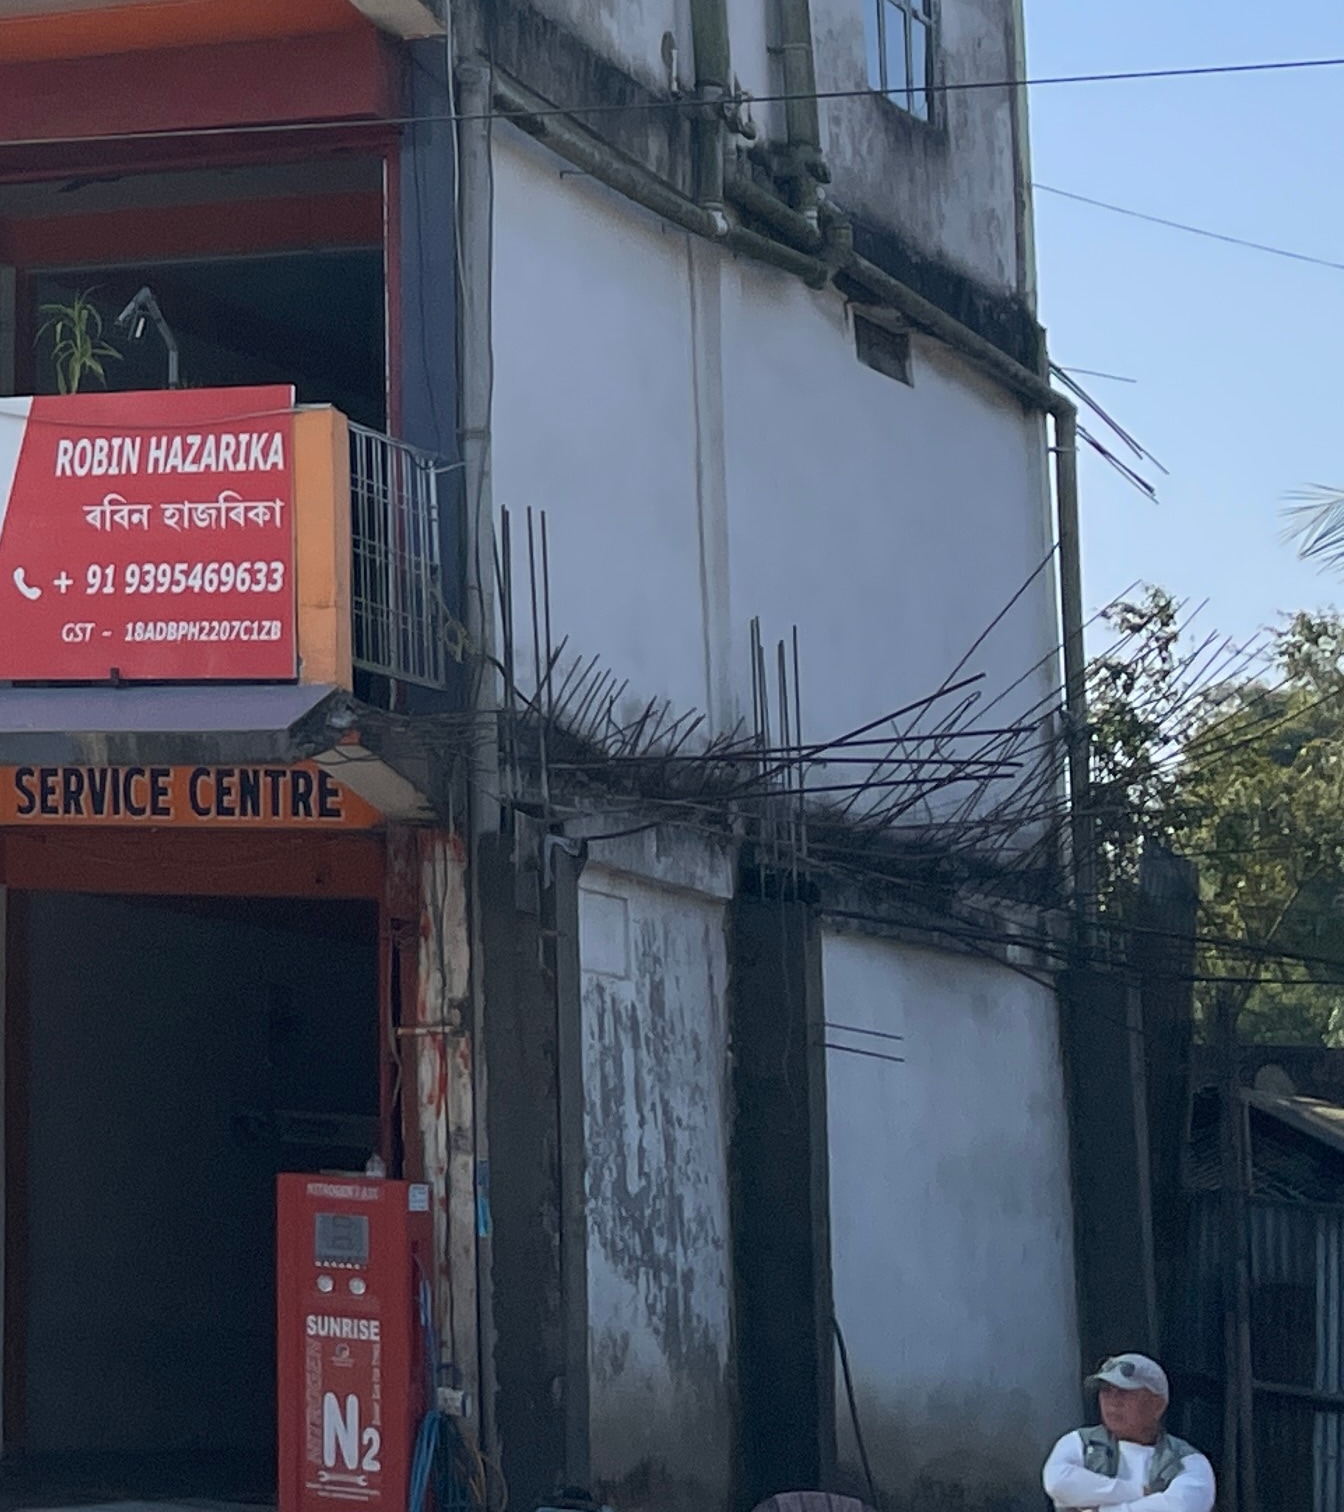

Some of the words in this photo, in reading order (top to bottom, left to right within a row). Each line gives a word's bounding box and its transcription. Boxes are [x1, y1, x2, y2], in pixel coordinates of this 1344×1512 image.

[55, 436, 141, 477] ROBIN
[147, 432, 285, 474] HAZARIKA
[86, 564, 115, 594] 91
[124, 561, 285, 594] 9395469633
[61, 622, 97, 643] GST
[15, 766, 174, 818] SERVICE
[189, 767, 344, 820] CENTRE
[306, 1315, 381, 1340] SUNRISE
[323, 1391, 381, 1472] N2
